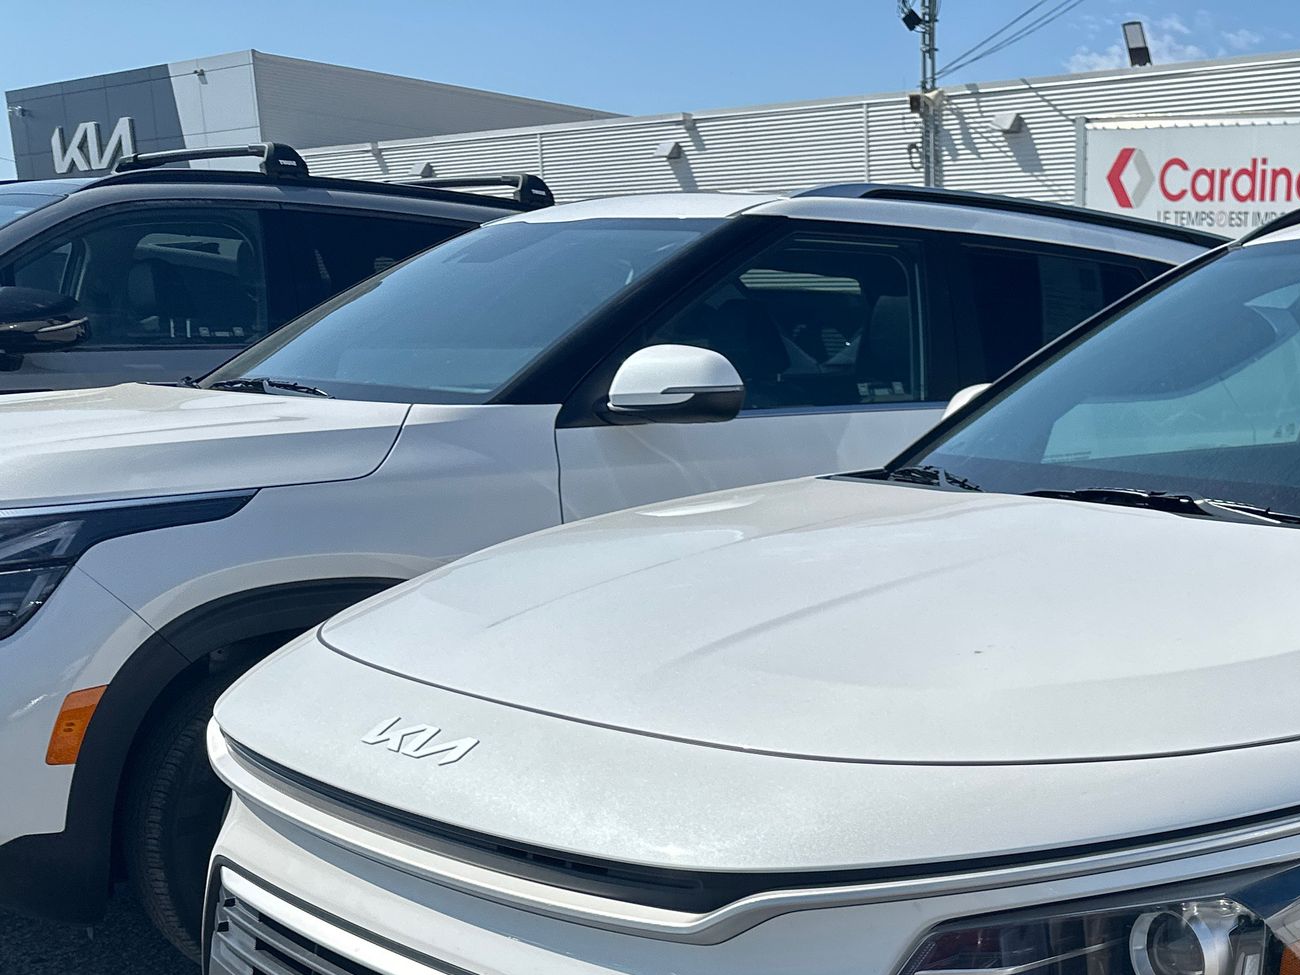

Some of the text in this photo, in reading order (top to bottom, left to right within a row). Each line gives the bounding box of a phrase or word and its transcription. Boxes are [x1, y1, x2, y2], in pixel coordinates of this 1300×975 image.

[51, 116, 135, 174] KIA
[1174, 210, 1215, 227] TEMPS
[361, 717, 480, 766] KIA
